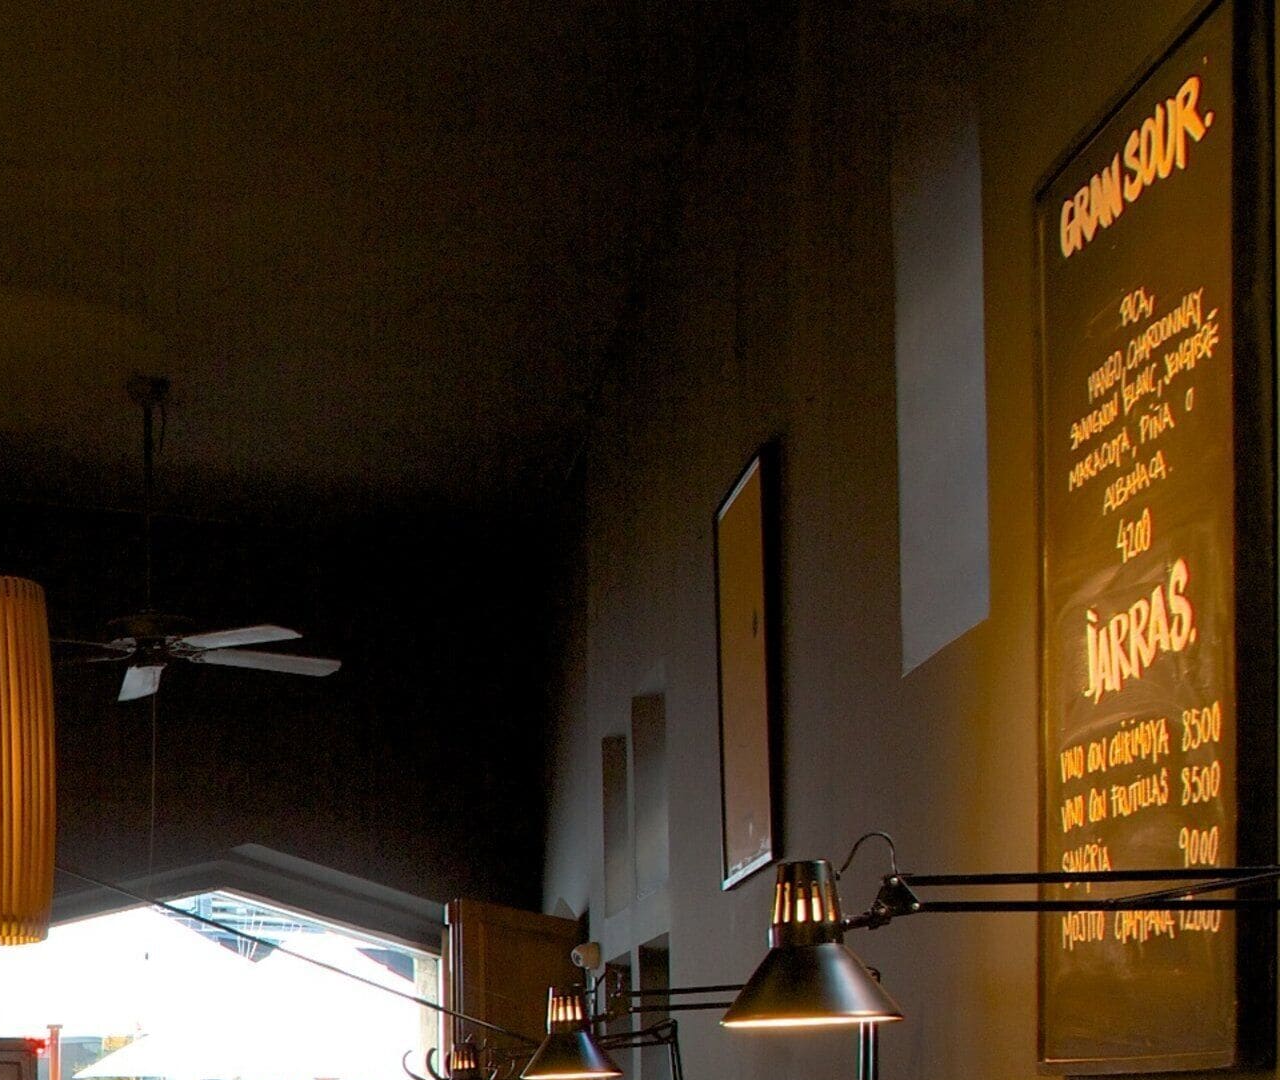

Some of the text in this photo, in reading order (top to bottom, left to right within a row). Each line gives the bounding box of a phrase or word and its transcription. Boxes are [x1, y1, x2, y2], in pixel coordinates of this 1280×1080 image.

[1060, 76, 1214, 257] GRAN SOUR.
[1127, 286, 1204, 370] CHARDONNAY
[1116, 508, 1152, 563] 4200
[1182, 700, 1221, 752] 8500
[1181, 760, 1221, 806] 8500
[1179, 826, 1219, 868] 9000
